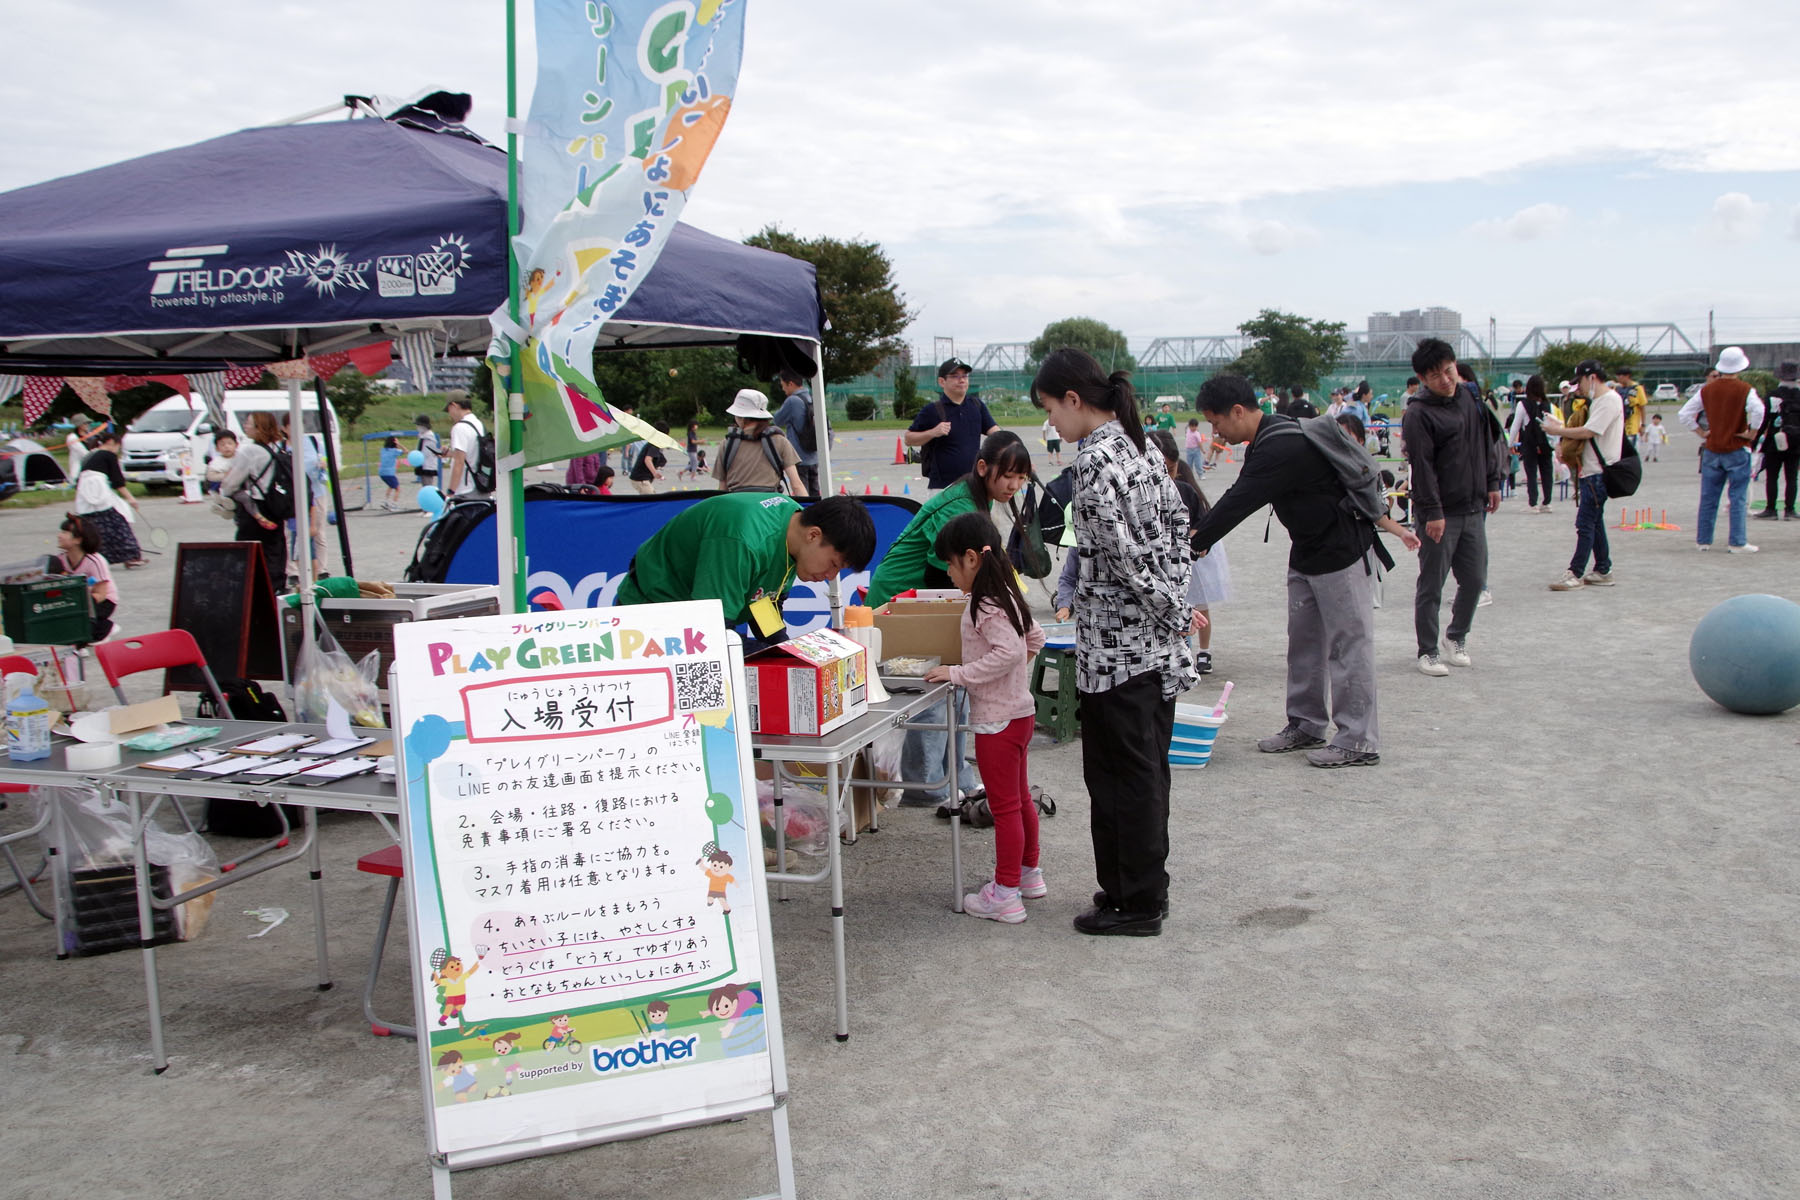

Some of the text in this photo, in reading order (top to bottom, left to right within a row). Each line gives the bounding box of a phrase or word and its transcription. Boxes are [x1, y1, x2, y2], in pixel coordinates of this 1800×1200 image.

[179, 265, 285, 293] FIELDOOR
[420, 272, 441, 287] UV
[151, 289, 285, 309] Powered by ottostyle.jp
[511, 617, 621, 634] プレイグリーンパーク
[427, 627, 707, 676] PLAY GREEN PARK
[508, 680, 632, 701] にゅうじょううけつけ
[501, 695, 635, 732] 入場受付
[462, 819, 656, 849] 免責事項にご署名ください。
[475, 867, 677, 898] マスク着用は任意となります。
[514, 898, 661, 928] あそぶルールをまもろう
[518, 1036, 696, 1079] supported by brother
